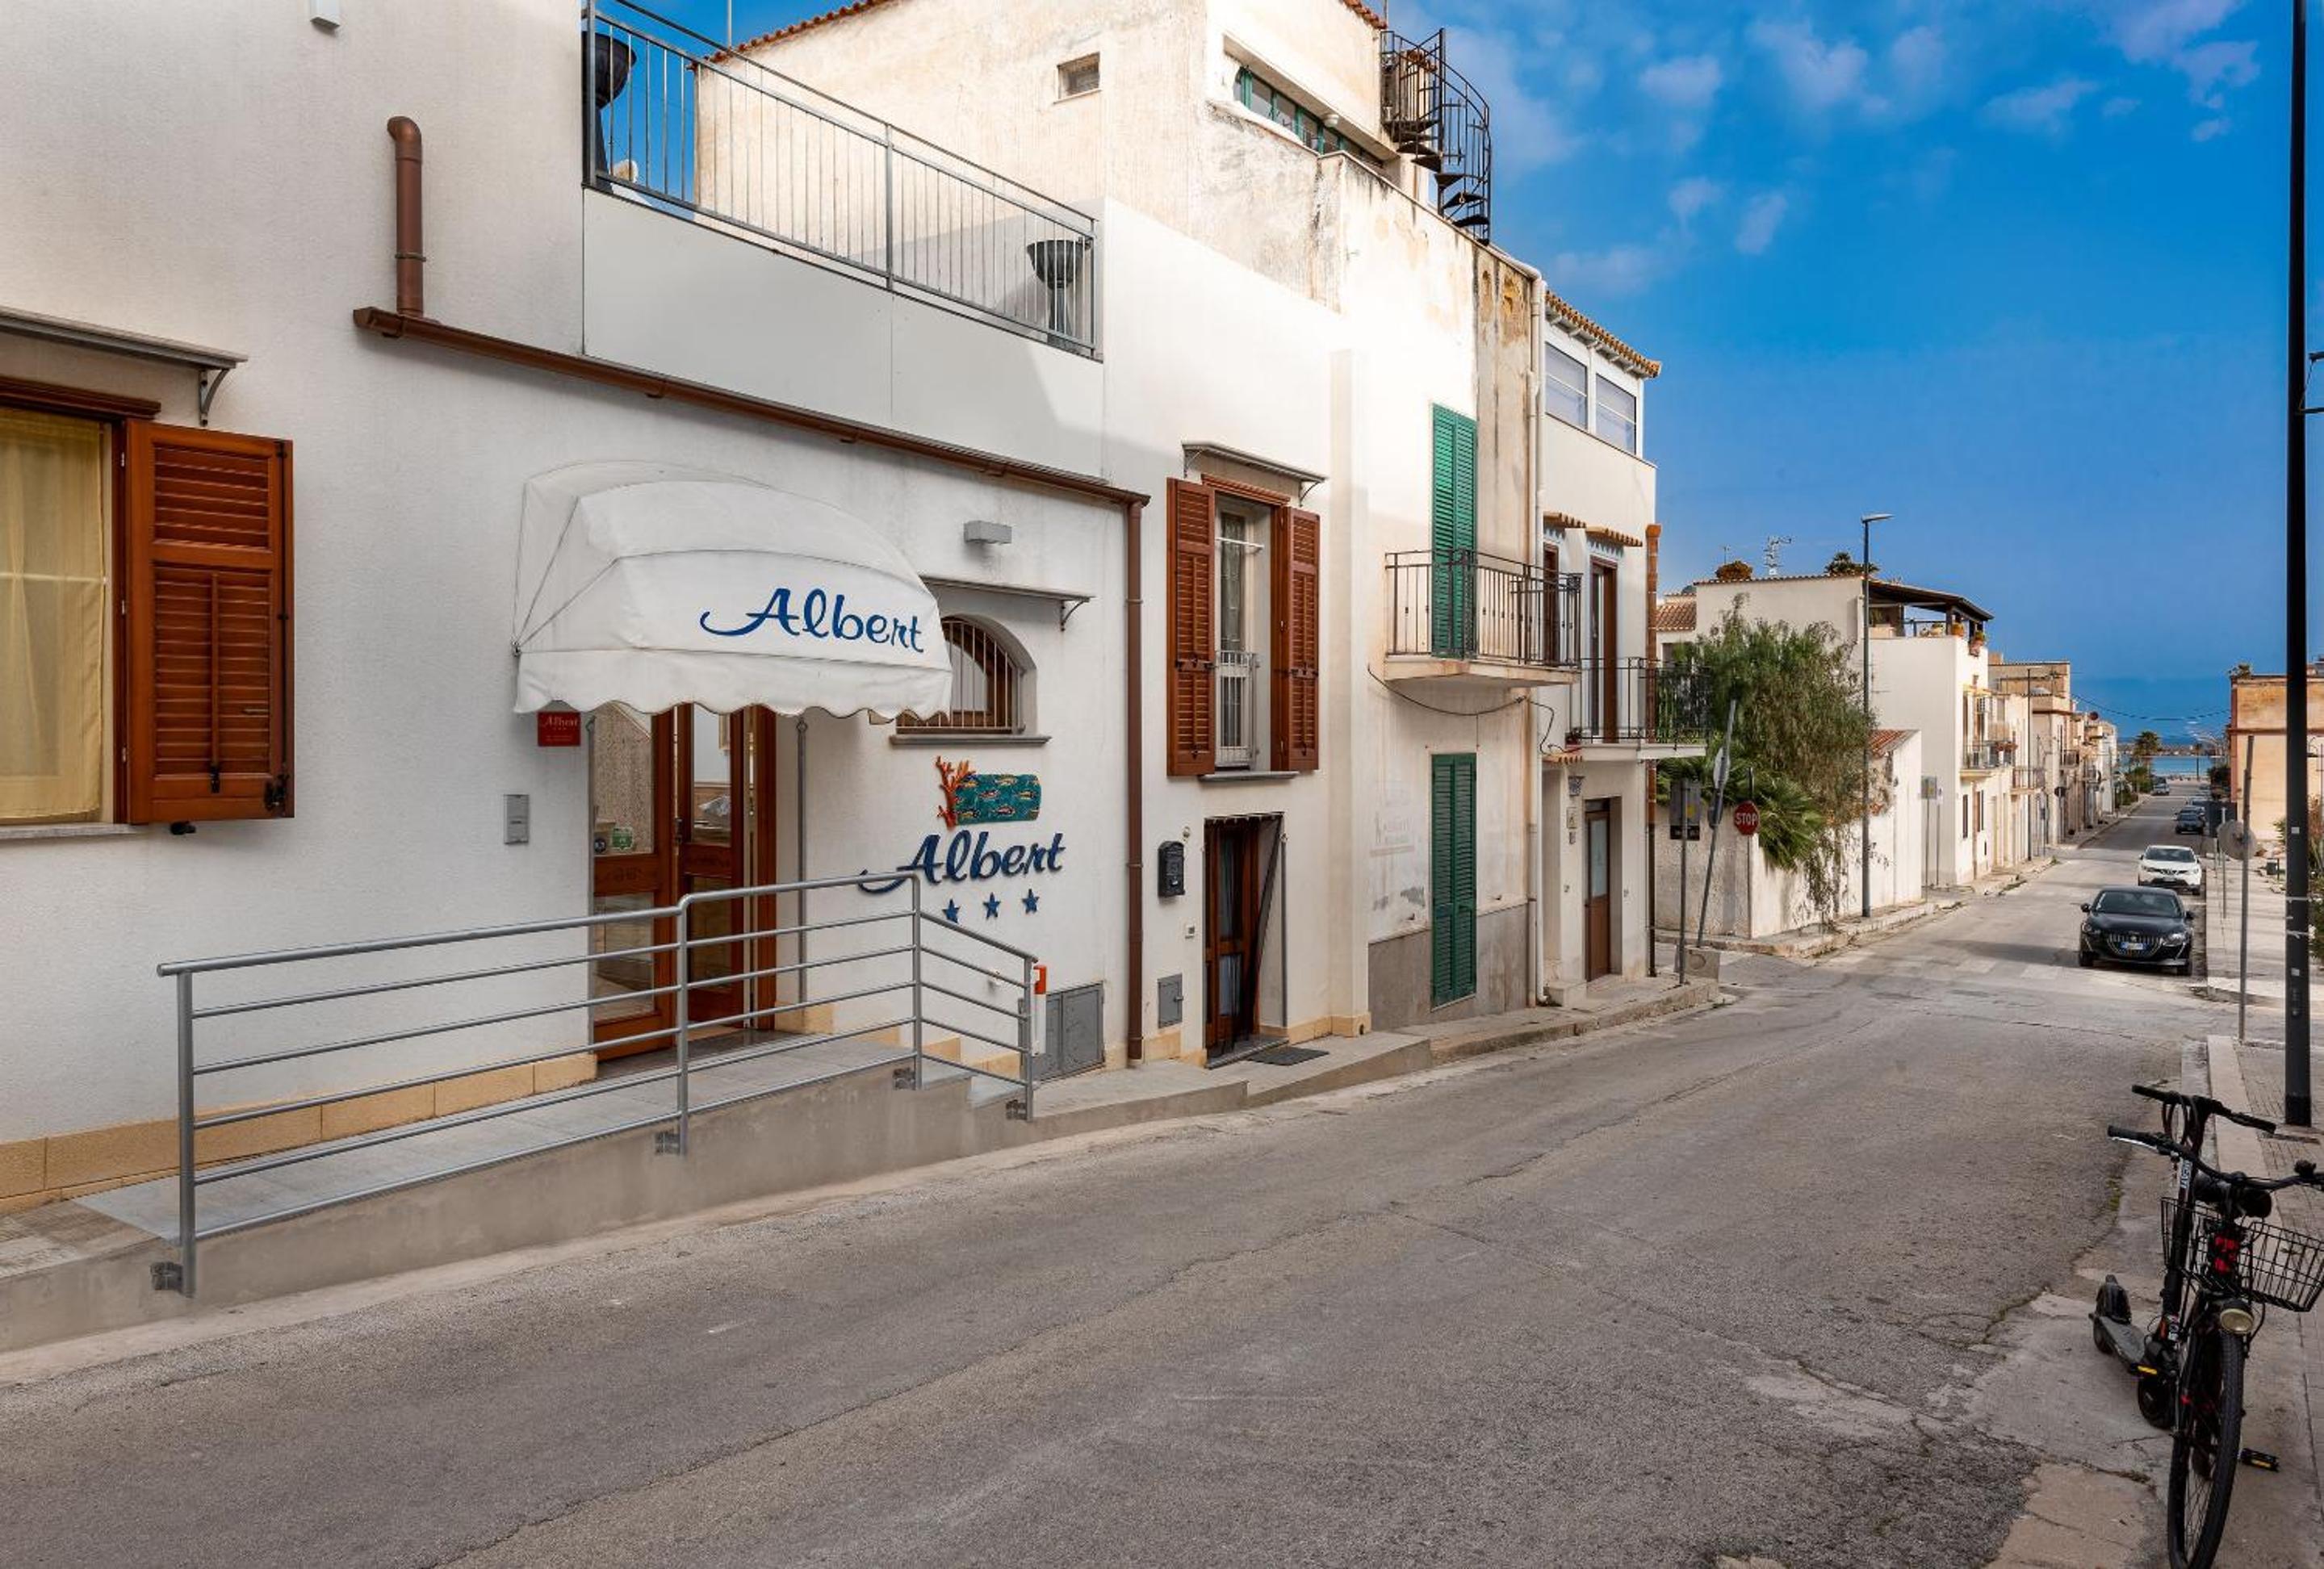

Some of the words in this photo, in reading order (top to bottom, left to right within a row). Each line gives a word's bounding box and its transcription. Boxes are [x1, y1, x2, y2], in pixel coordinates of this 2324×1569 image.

[700, 588, 924, 652] Albert
[1736, 812, 1757, 826] STOP
[856, 830, 1066, 893] Albert
